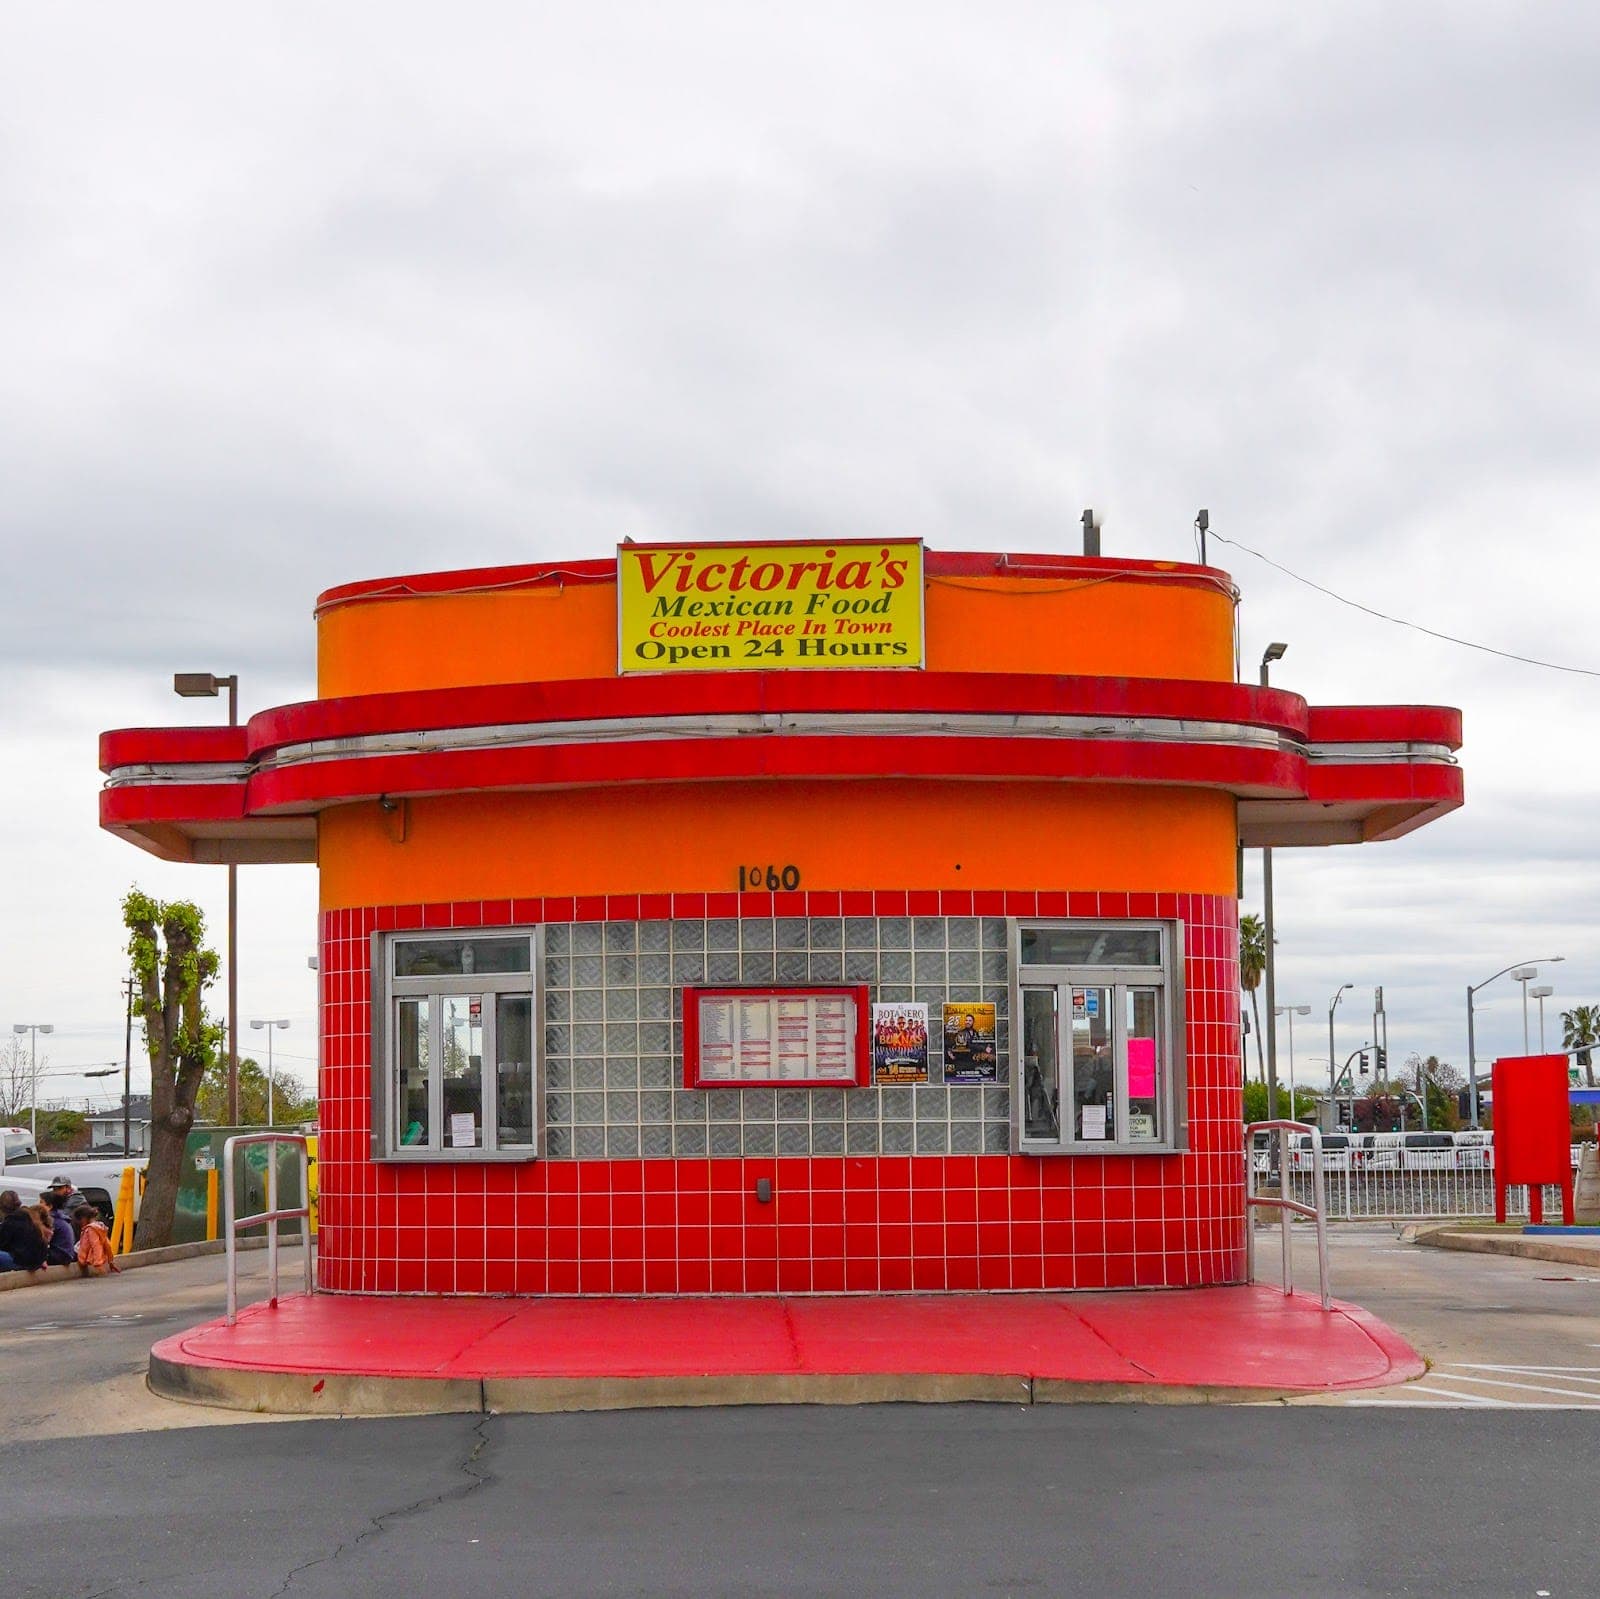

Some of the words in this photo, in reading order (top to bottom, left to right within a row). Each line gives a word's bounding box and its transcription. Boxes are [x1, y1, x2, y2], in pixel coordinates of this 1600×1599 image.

[633, 549, 908, 594] Victoria's
[651, 595, 794, 618] Mexican
[804, 592, 892, 615] Food
[649, 621, 731, 638] Coolest
[736, 620, 795, 636] Place
[802, 619, 827, 635] In
[835, 618, 892, 635] Town
[635, 641, 731, 664] Open
[743, 639, 784, 657] 24
[796, 638, 908, 656] Hours
[739, 865, 800, 891] 1060
